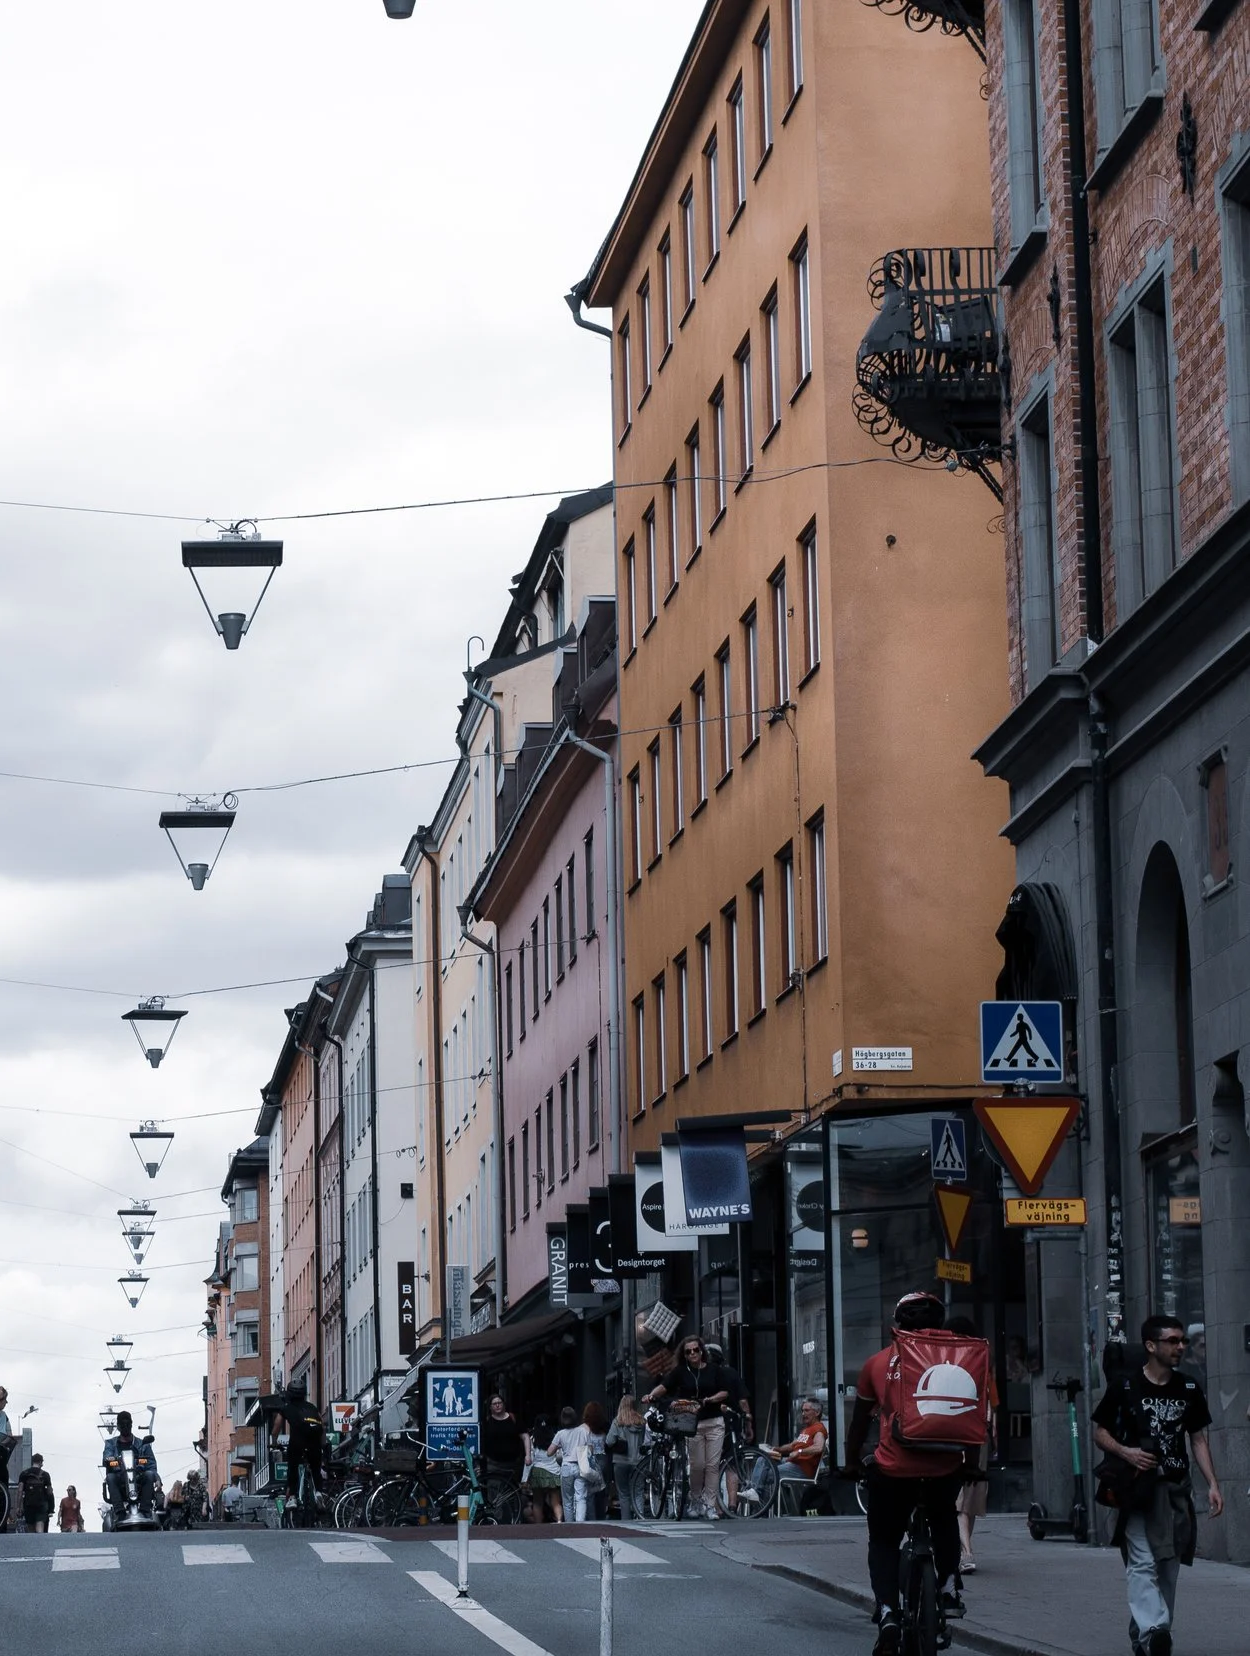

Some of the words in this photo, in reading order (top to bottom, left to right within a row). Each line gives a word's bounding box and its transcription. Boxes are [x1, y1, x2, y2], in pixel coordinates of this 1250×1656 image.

[855, 1061, 877, 1069] 36-28
[641, 1203, 662, 1212] Aspire
[1018, 1200, 1076, 1211] Flervägs-
[1026, 1212, 1070, 1223] väjning
[617, 1257, 666, 1268] Designtorget
[550, 1237, 568, 1306] GRANIT
[402, 1284, 413, 1324] BAR
